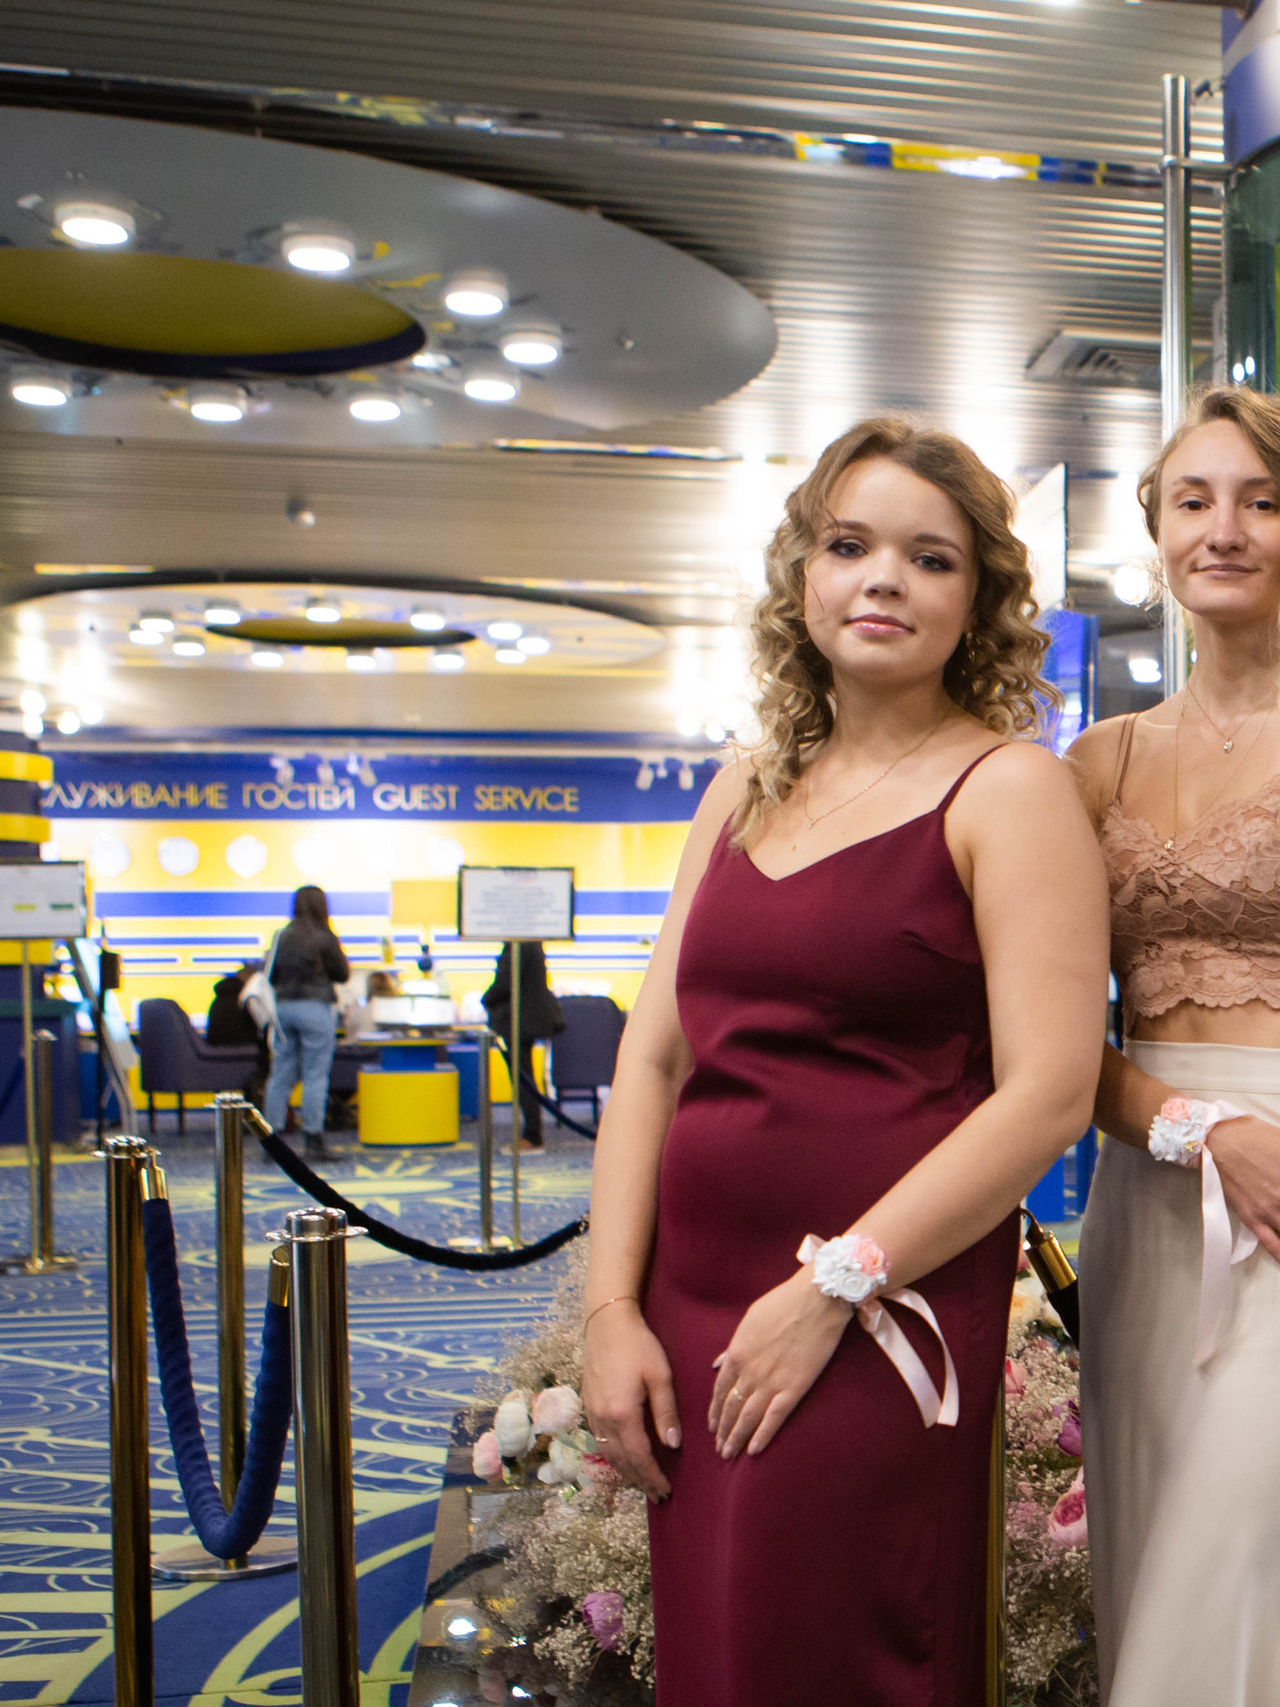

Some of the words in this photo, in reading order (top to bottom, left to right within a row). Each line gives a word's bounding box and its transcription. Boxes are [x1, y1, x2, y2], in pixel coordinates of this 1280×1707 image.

[39, 782, 228, 809] ЛУЖИВАНИЕ
[241, 779, 356, 811] ГОСТЕЙ
[372, 784, 459, 811] GUEST
[474, 786, 580, 812] SERVICE
